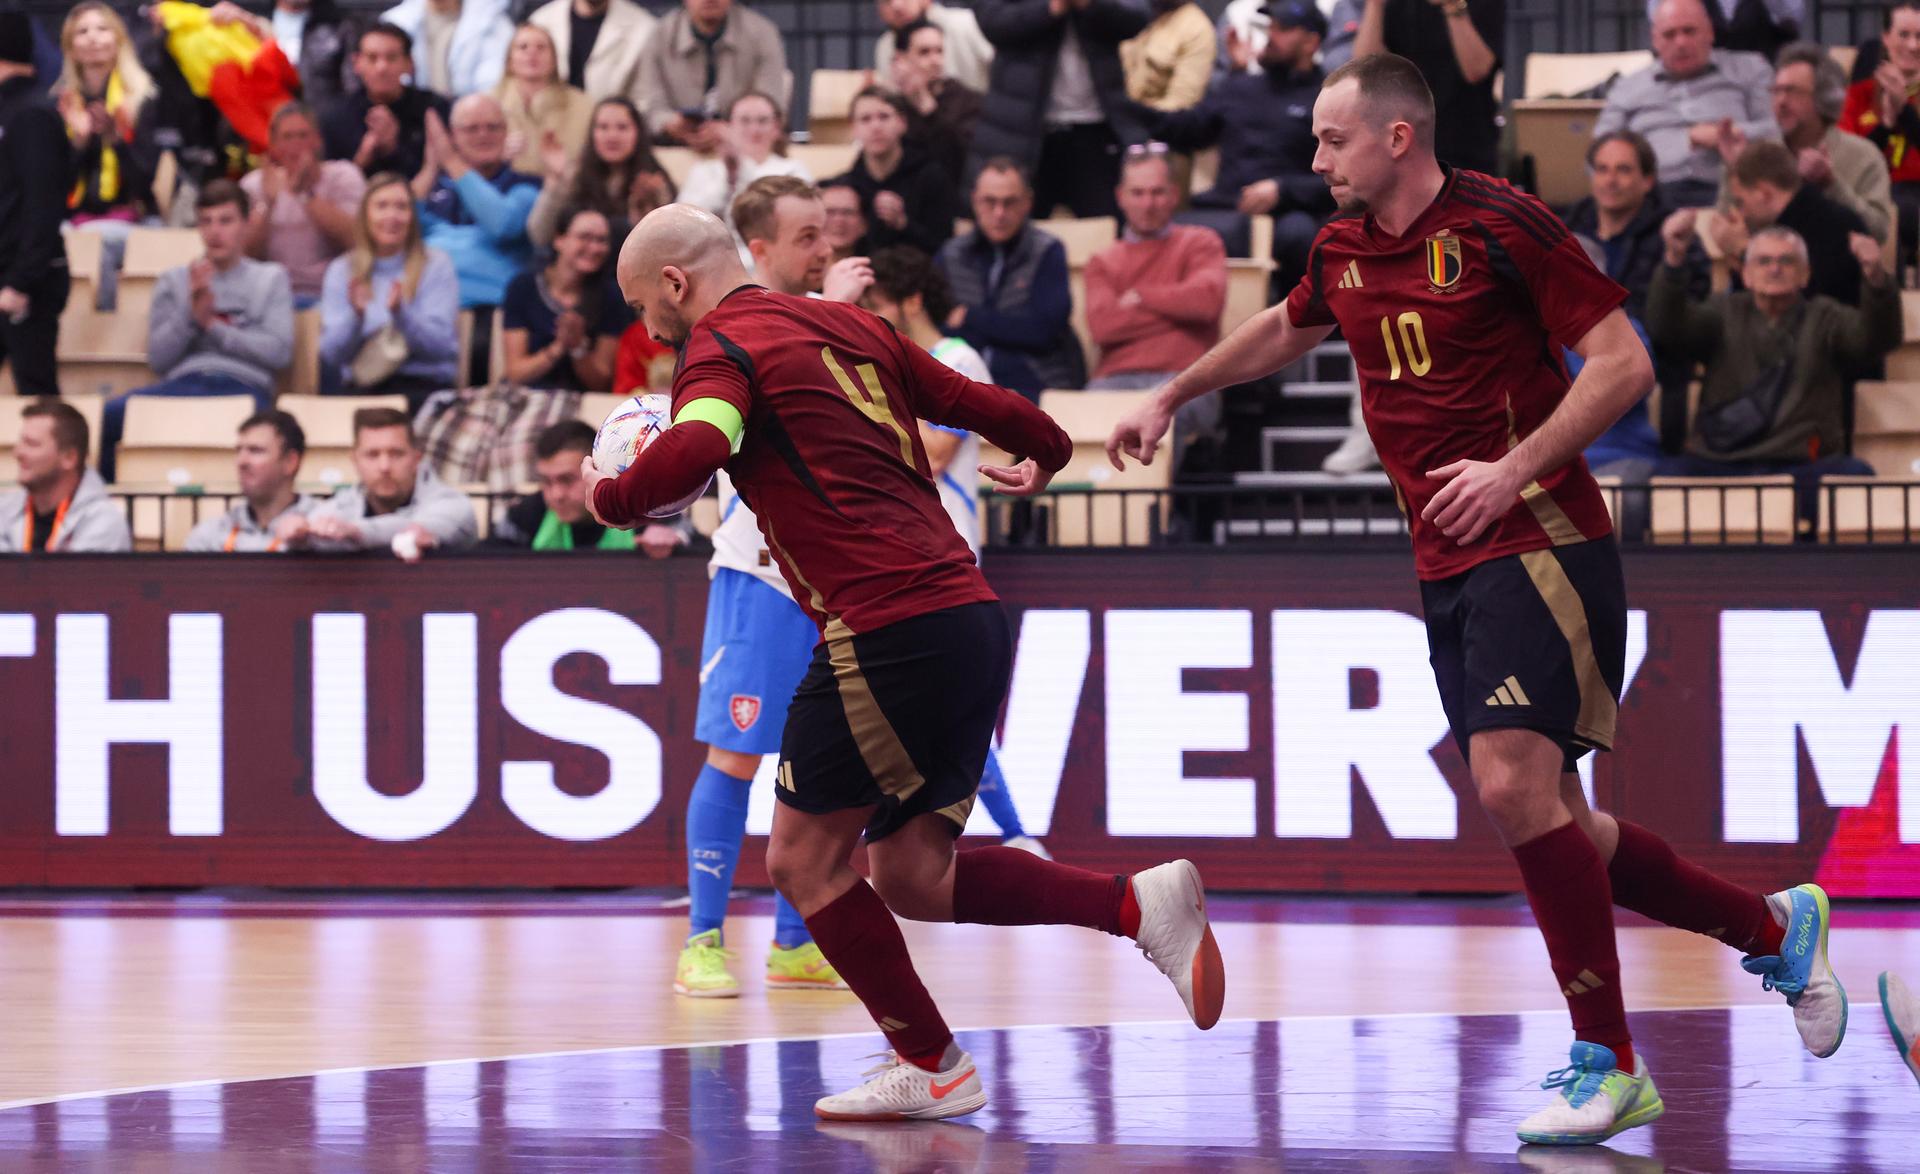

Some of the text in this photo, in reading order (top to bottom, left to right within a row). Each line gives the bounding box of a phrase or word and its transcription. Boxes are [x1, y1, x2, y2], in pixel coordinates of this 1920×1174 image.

[821, 345, 917, 471] 4
[1380, 311, 1432, 380] 10
[0, 612, 224, 837] H
[311, 607, 663, 842] US
